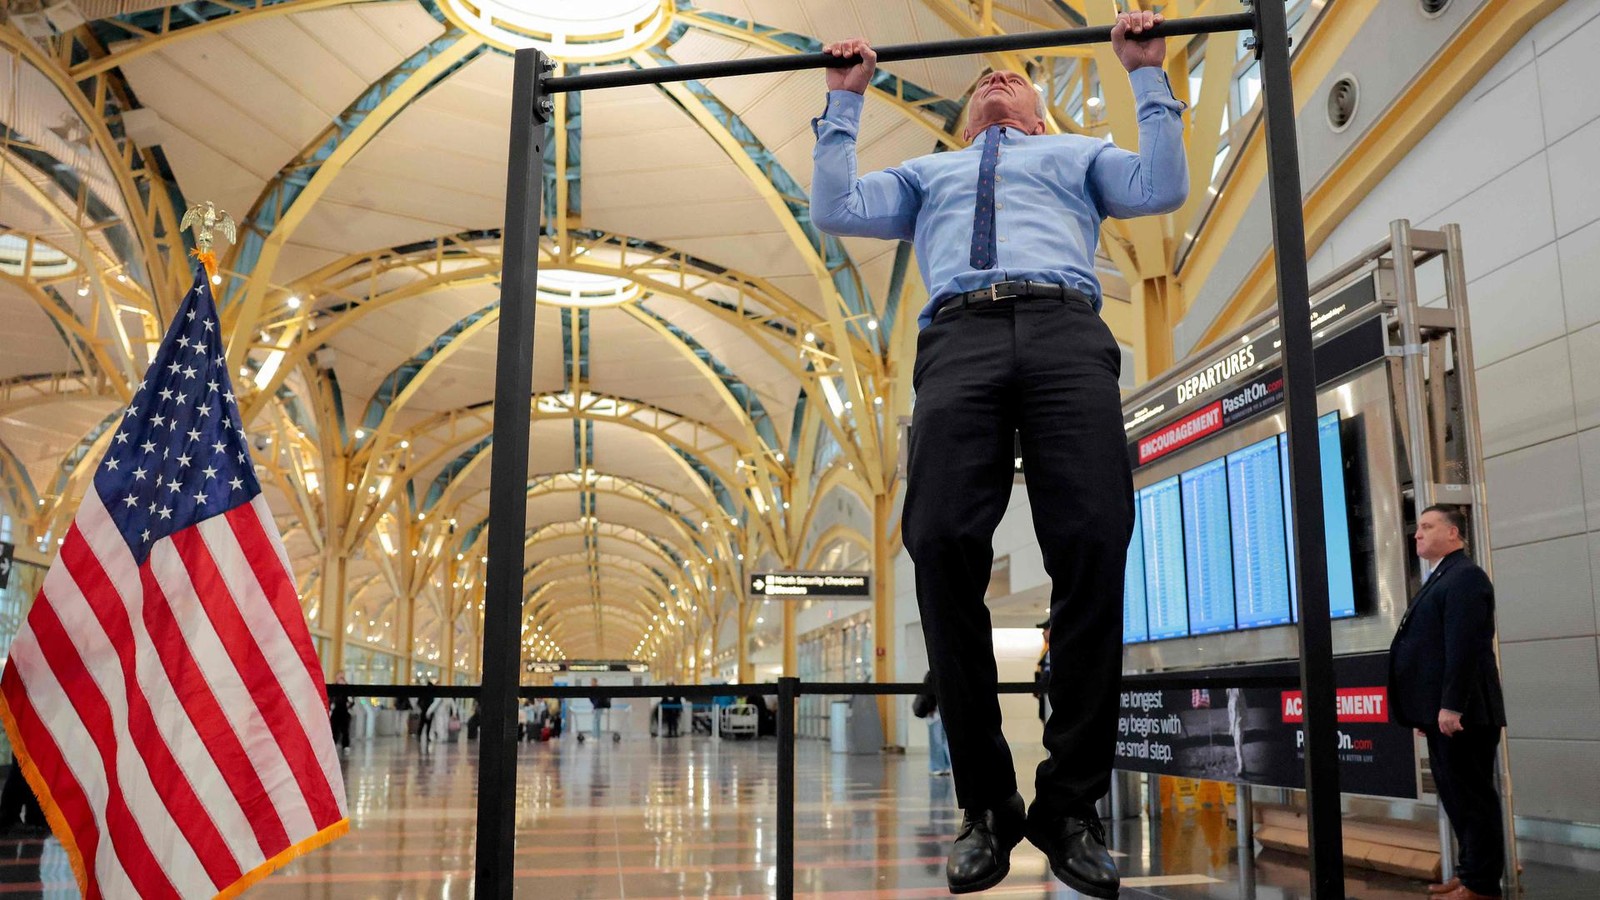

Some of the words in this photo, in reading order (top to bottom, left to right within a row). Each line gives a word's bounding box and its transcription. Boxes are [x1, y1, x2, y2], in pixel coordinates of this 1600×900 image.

[1177, 345, 1255, 404] DEPARTURES
[1222, 378, 1284, 415] PassItOn.com
[1140, 409, 1220, 458] ENCOURAGEMENT
[796, 575, 824, 587] Security
[824, 576, 864, 587] Checkpoint
[1130, 690, 1163, 712] longest
[1130, 714, 1160, 737] begins
[1160, 713, 1181, 734] with
[1126, 740, 1149, 758] small
[1150, 741, 1173, 764] step.
